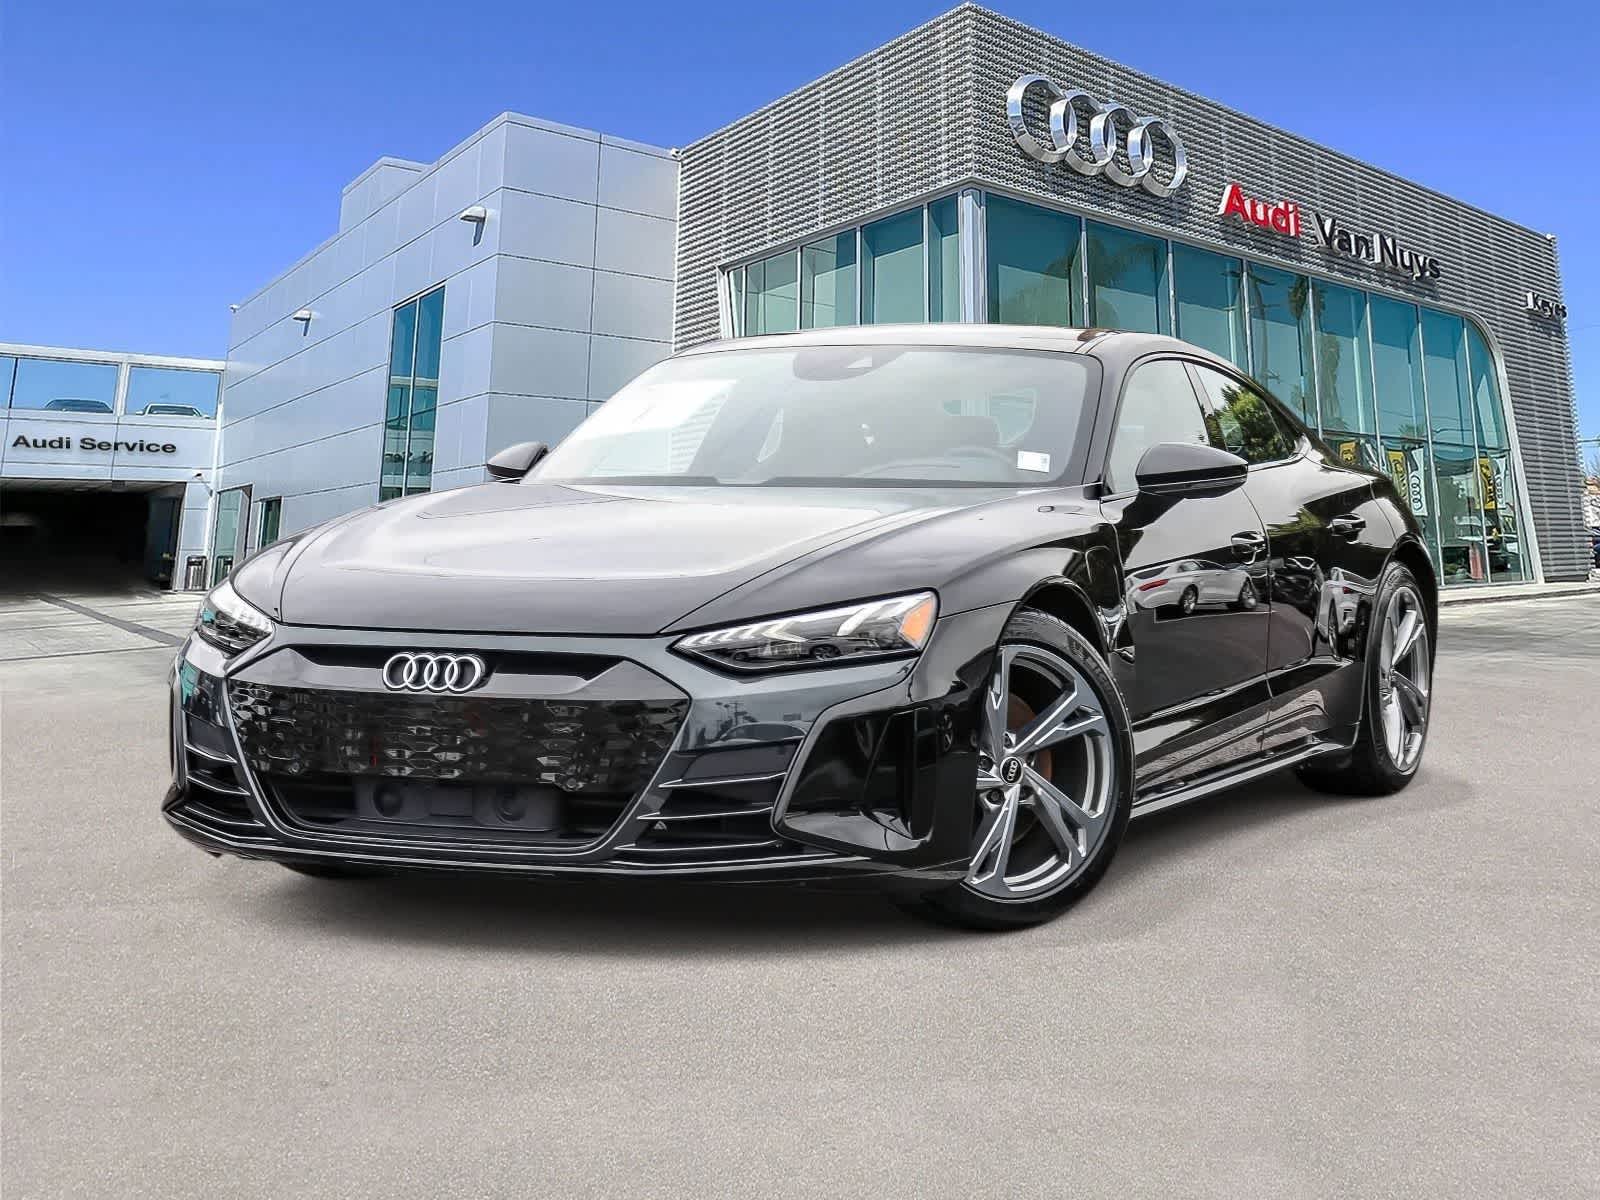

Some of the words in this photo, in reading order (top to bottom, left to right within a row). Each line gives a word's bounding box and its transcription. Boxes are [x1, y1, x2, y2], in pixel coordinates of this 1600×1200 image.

[1218, 183, 1302, 237] Audi
[1310, 213, 1372, 259] Van
[1374, 232, 1441, 280] Nuys
[12, 435, 71, 449] Audi
[79, 437, 177, 454] Service
